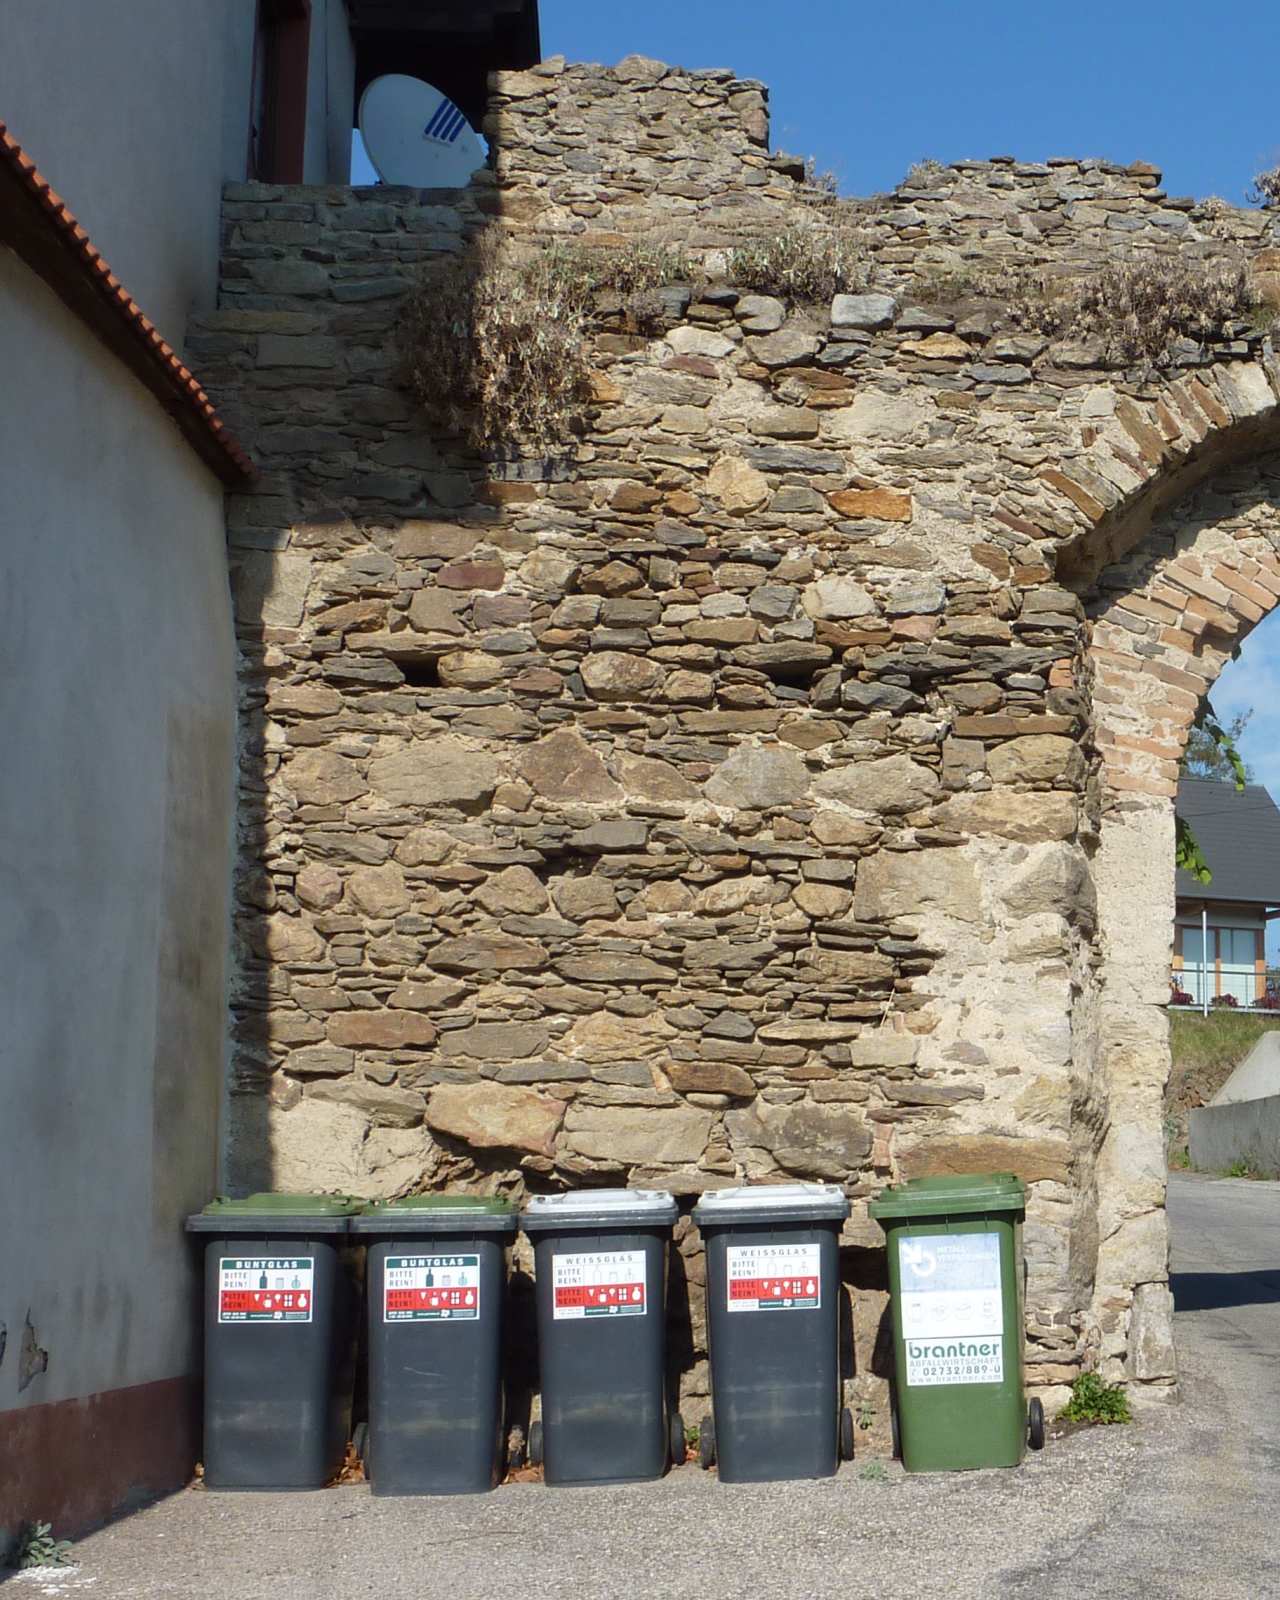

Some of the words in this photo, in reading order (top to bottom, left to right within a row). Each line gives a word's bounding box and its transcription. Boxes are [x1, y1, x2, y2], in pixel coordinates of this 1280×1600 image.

[740, 1248, 807, 1257] WEISSGLAS
[401, 1258, 464, 1267] BUNTGLAS
[566, 1255, 633, 1264] WEISSGLAS
[235, 1260, 298, 1269] BUNTGLAS
[732, 1260, 756, 1268] BITTE
[557, 1268, 581, 1276] BITTE
[732, 1269, 756, 1277] REIN!
[557, 1277, 581, 1285] REIN!
[732, 1281, 756, 1289] BITTE
[388, 1291, 412, 1299] BITTE
[557, 1288, 581, 1296] BITTE
[732, 1290, 756, 1298] NEIN!
[388, 1300, 412, 1308] NEIN!
[557, 1297, 581, 1305] NEIN!
[909, 1341, 1000, 1359] brantner
[909, 1357, 1000, 1367] ABFALLWIRTSCHAFT
[910, 1374, 1001, 1383] www.brantner.com
